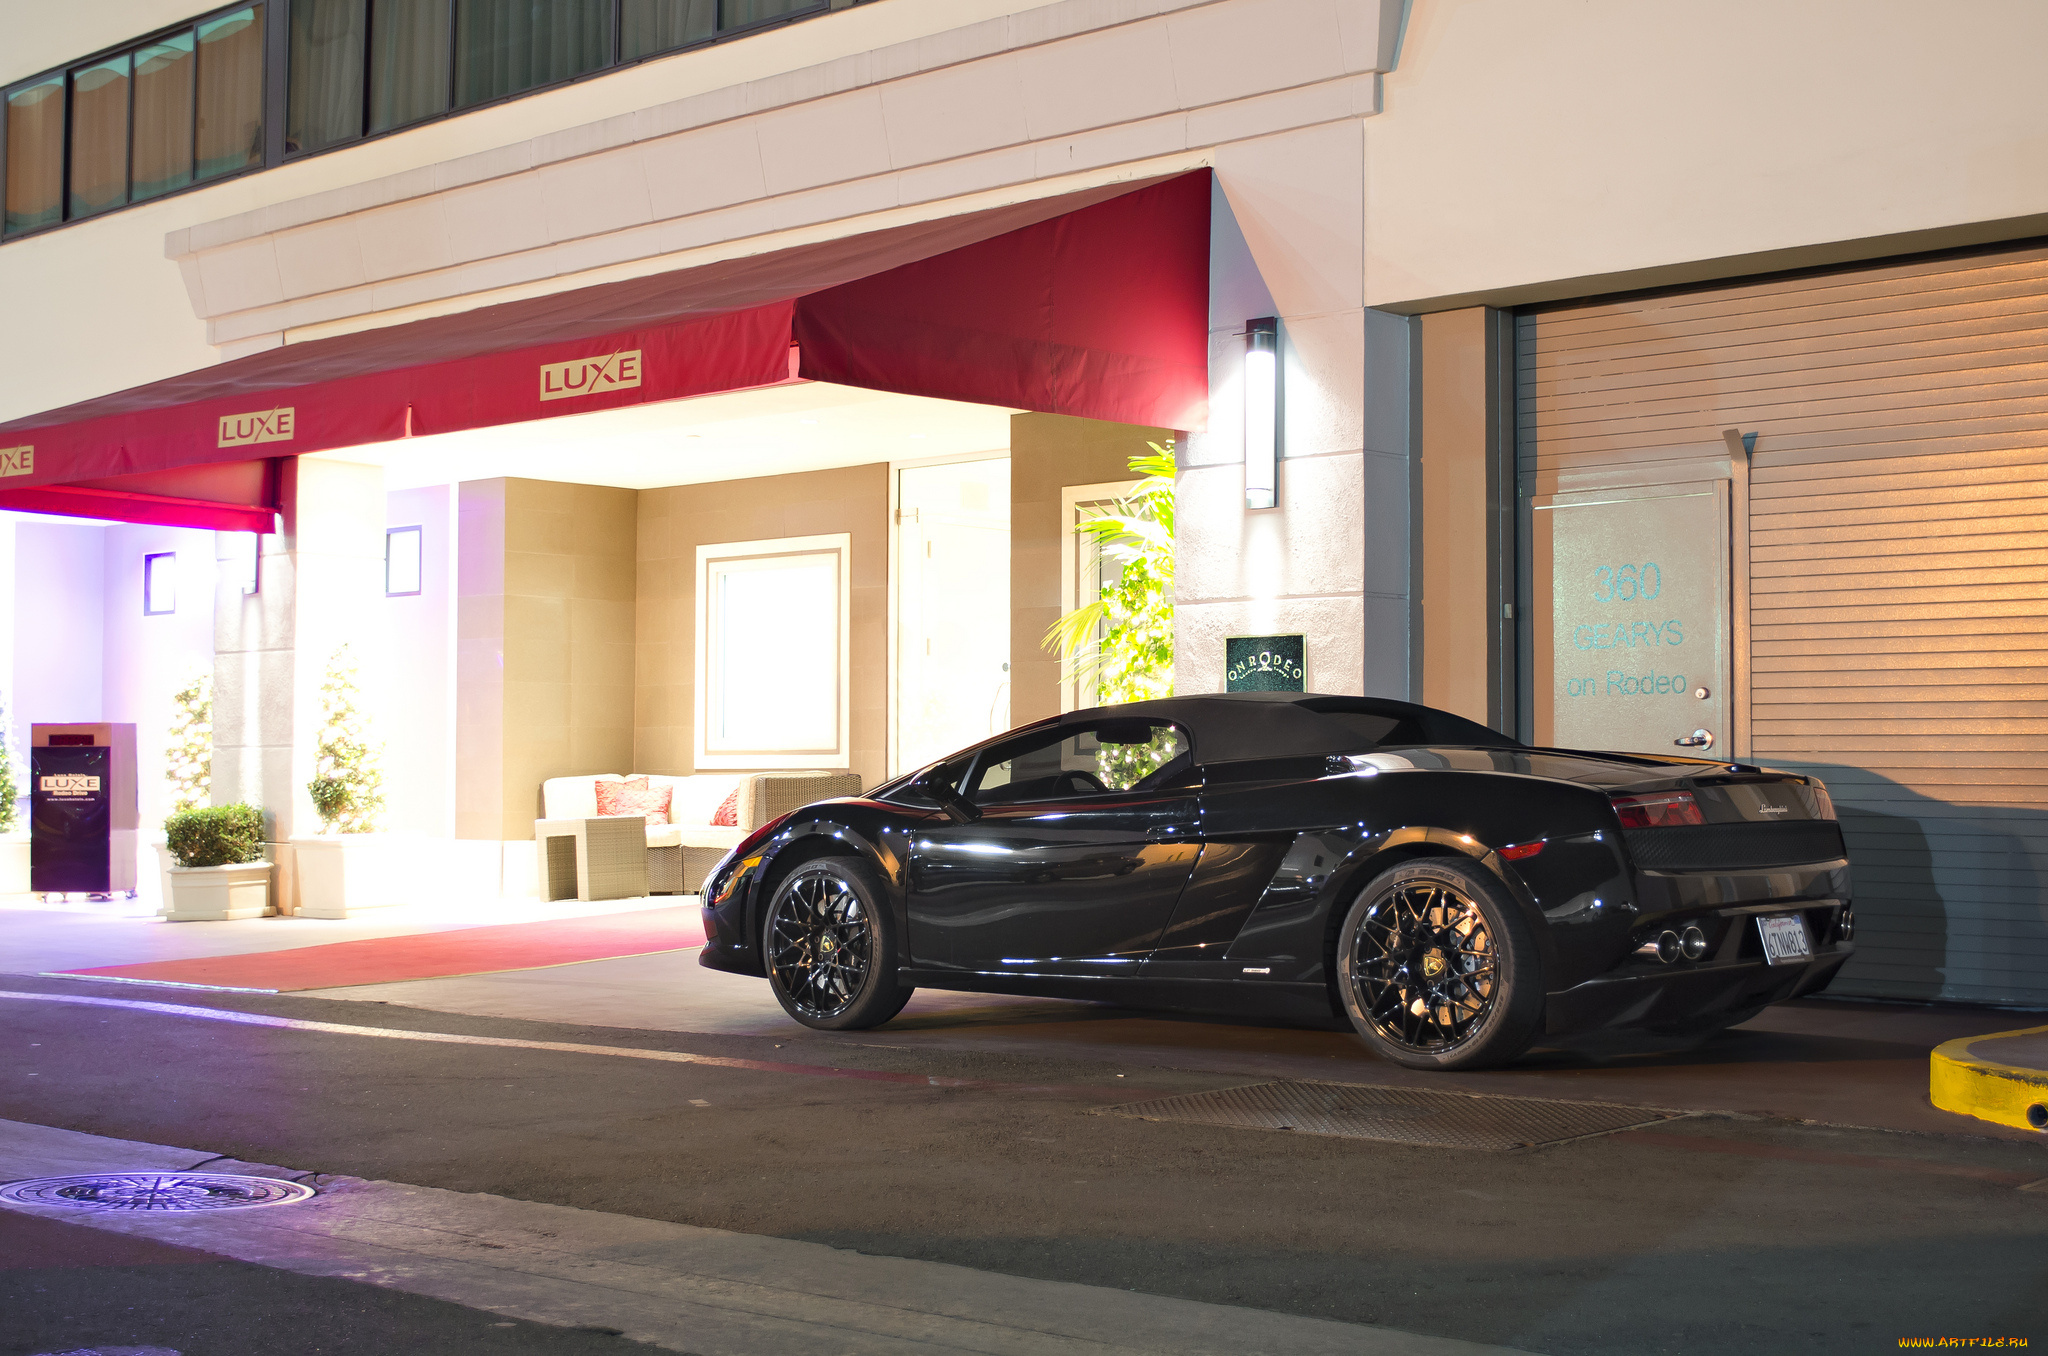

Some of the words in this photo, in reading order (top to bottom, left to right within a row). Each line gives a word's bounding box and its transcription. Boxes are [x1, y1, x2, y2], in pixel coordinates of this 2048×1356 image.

[545, 347, 638, 393] LUXE
[222, 404, 291, 442] LUXE
[0, 444, 32, 476] XE
[1594, 562, 1661, 603] 360
[1573, 619, 1684, 651] GEARYS
[1228, 660, 1246, 681] ON
[1248, 651, 1302, 679] RODEO
[1567, 677, 1596, 697] on
[1606, 669, 1687, 696] Rodeo
[44, 777, 98, 790] LUXE
